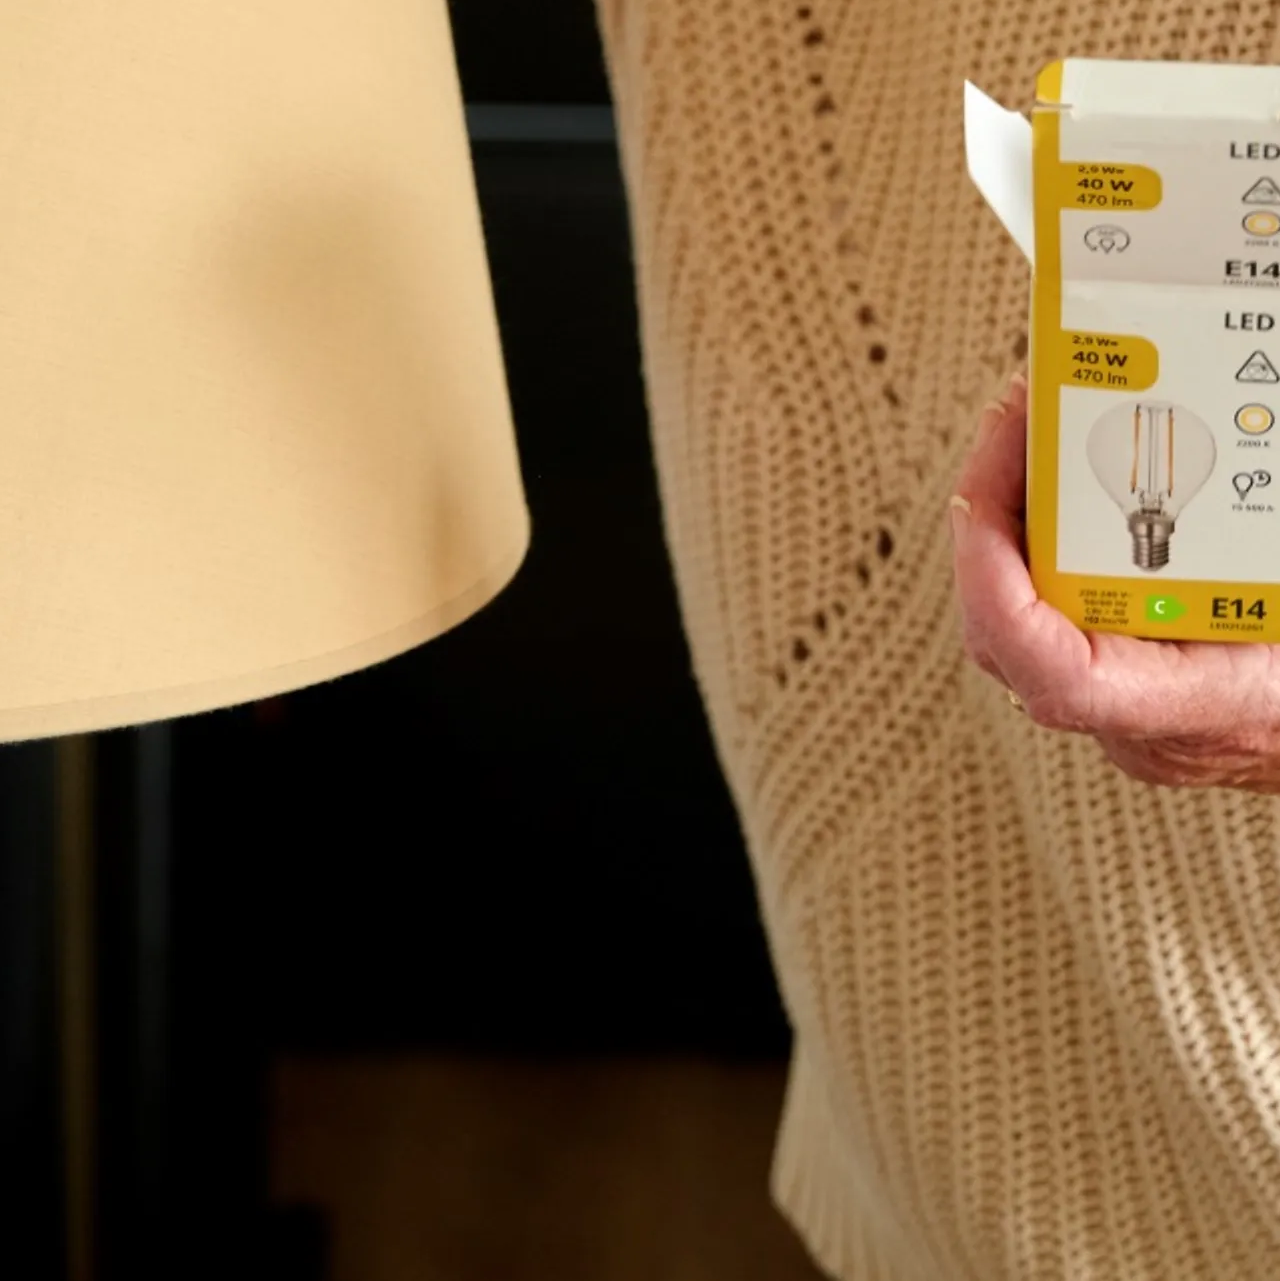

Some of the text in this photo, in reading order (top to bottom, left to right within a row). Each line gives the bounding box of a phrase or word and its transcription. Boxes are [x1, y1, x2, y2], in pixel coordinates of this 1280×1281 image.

[1077, 178, 1134, 192] 40 W
[1076, 193, 1133, 207] 470 lm
[1224, 311, 1275, 332] LED
[1072, 351, 1128, 367] 40 W
[1072, 369, 1128, 386] 470 lm
[1153, 600, 1166, 615] C
[1212, 597, 1267, 620] E14
